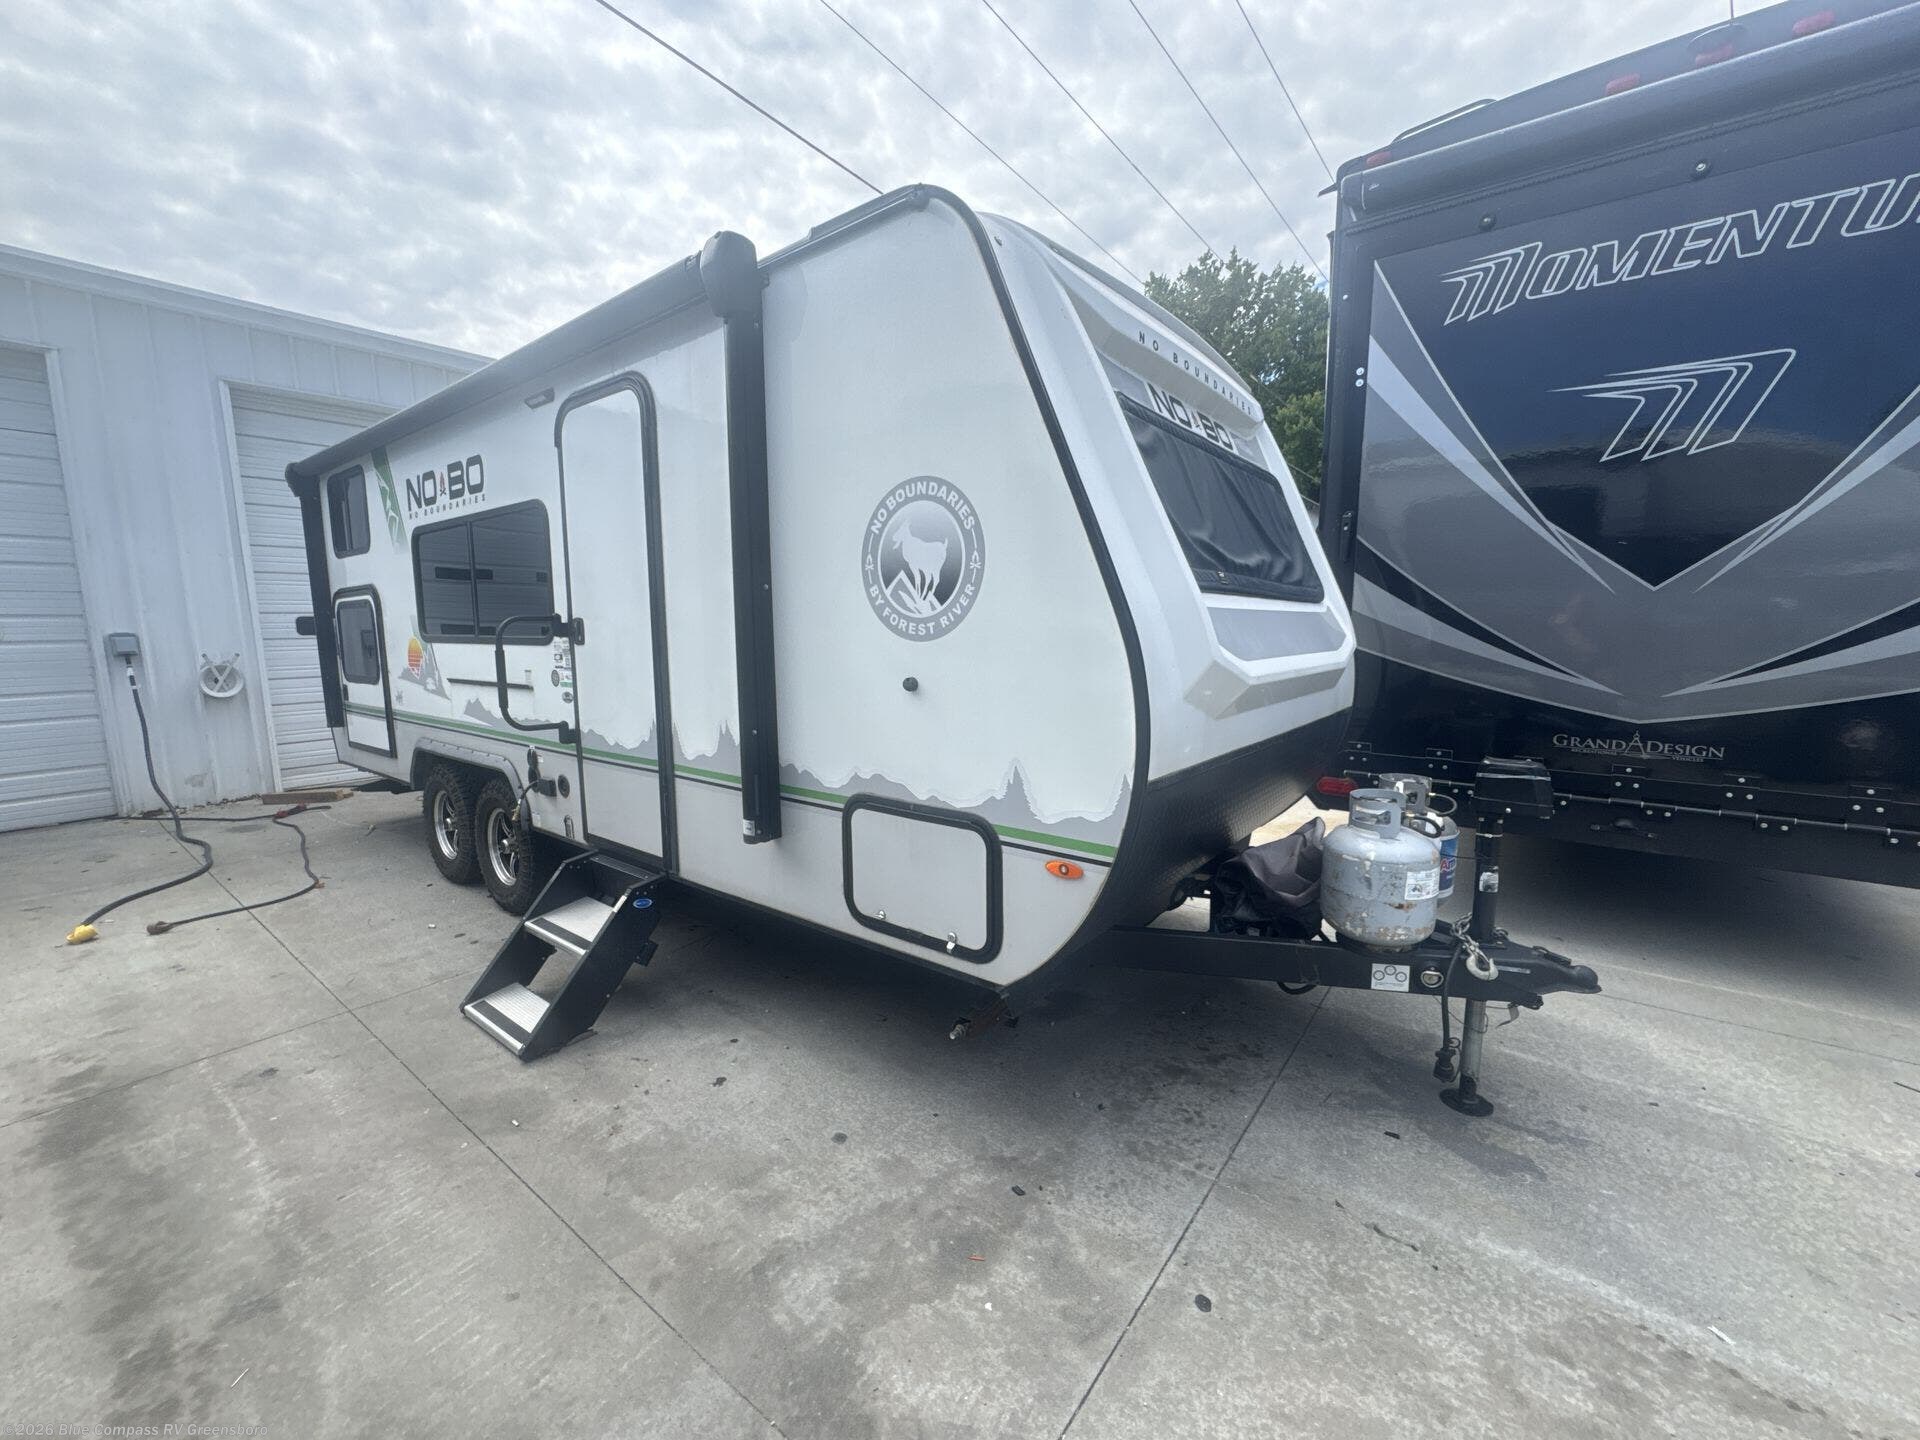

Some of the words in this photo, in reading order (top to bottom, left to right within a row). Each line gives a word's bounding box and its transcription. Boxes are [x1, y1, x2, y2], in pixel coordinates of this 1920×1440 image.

[1440, 173, 1920, 326] MOMENTU
[1138, 331, 1159, 351] NO
[871, 509, 887, 535] NO
[886, 481, 976, 531] BOUNDARIES
[869, 584, 885, 607] BY
[882, 607, 936, 636] FOREST
[940, 583, 976, 628] RIVER
[1646, 740, 1725, 758] DESIGN
